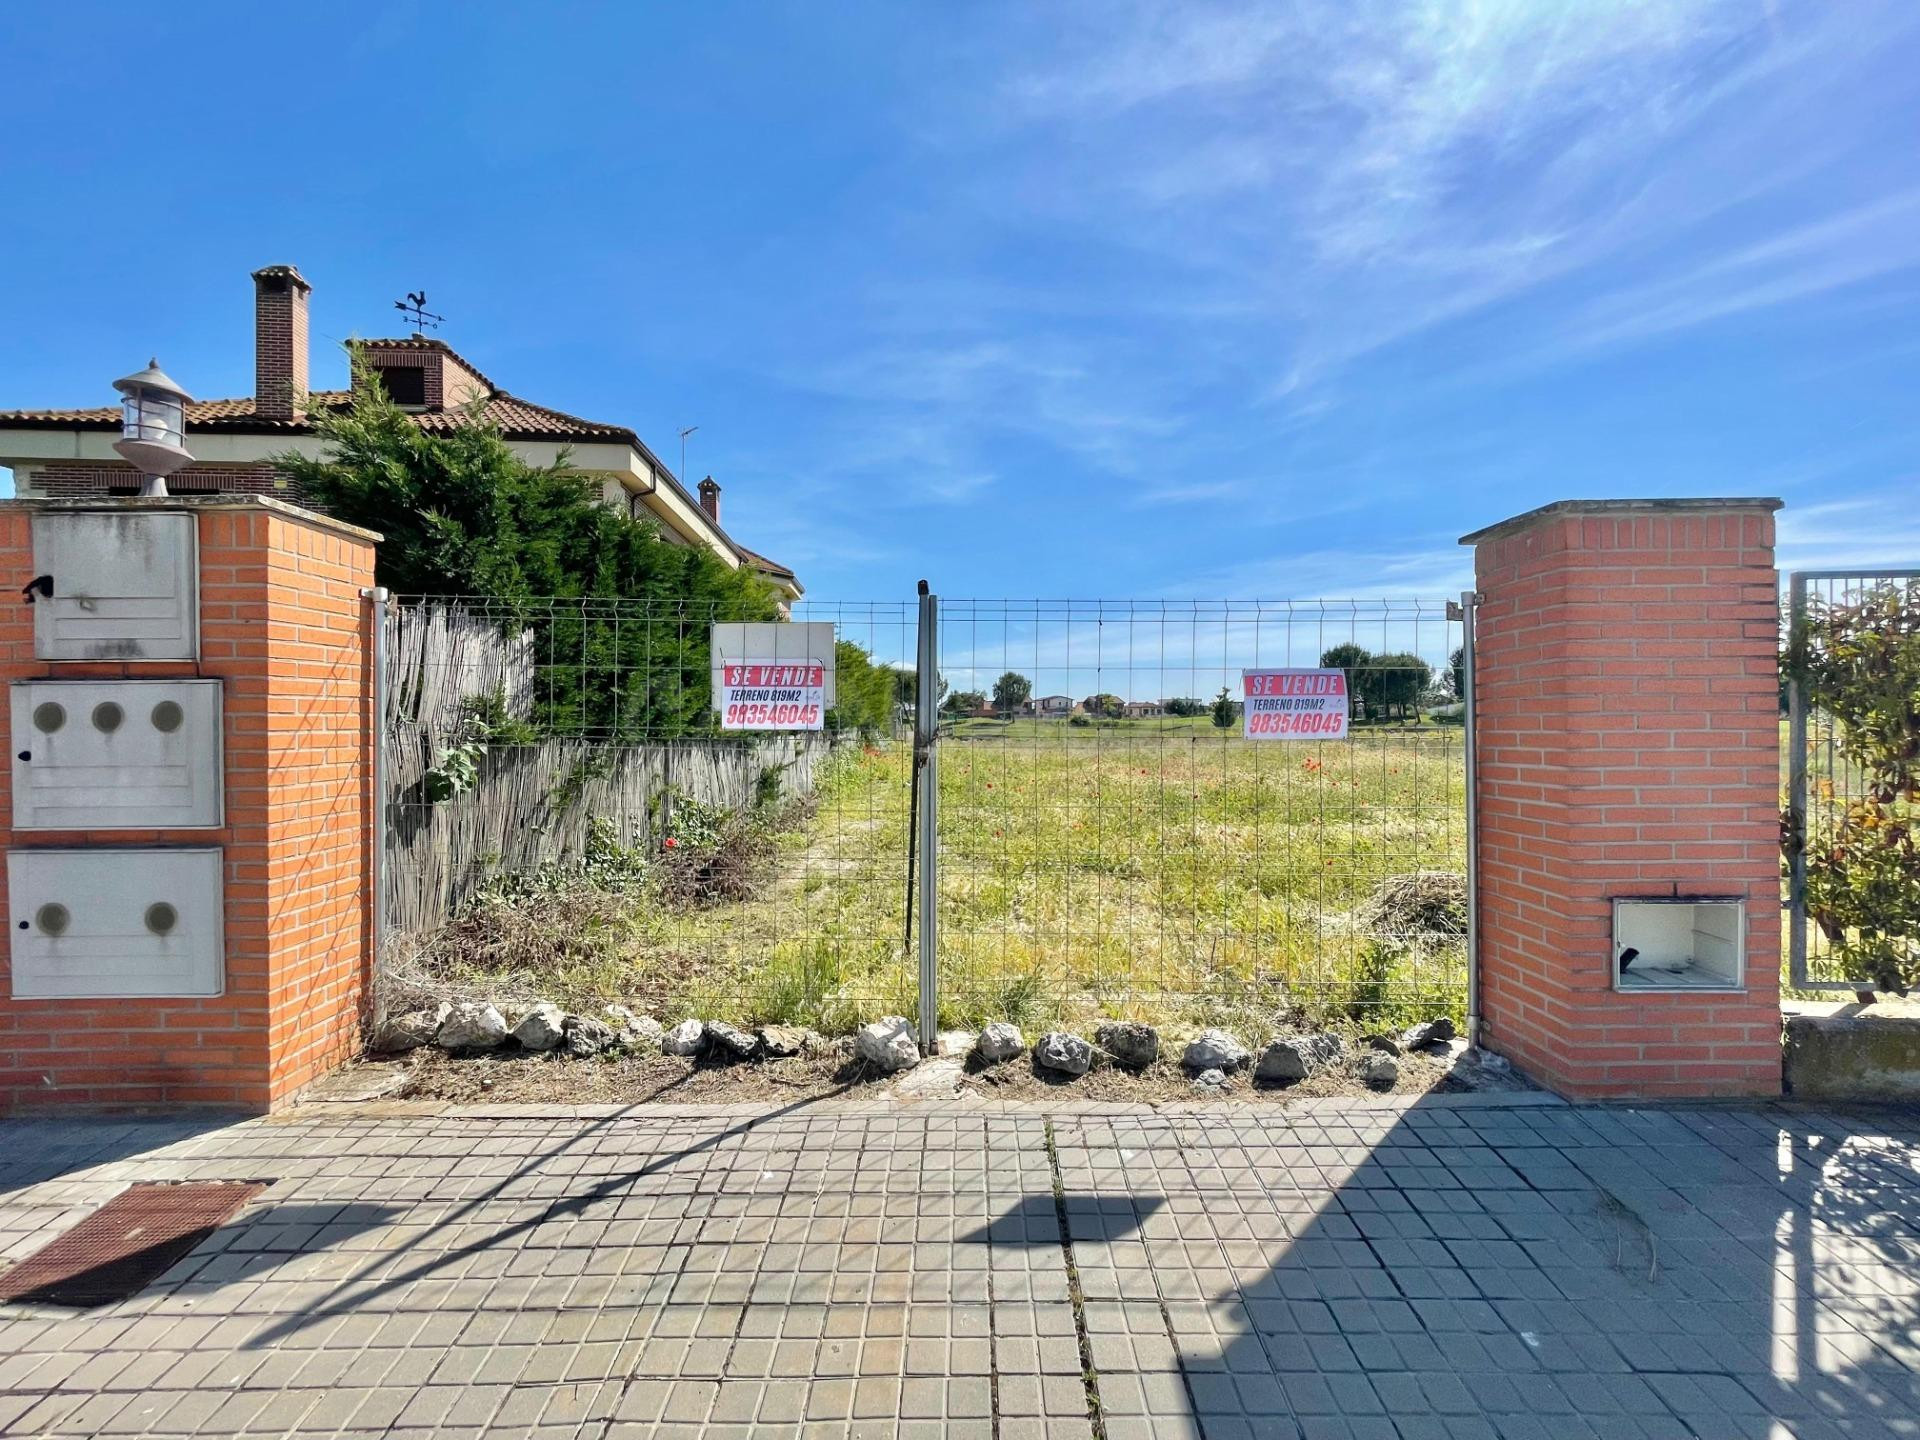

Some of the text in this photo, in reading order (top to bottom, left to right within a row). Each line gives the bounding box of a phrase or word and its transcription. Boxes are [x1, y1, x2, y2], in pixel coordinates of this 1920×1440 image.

[731, 667, 816, 685] SE VENDE
[1253, 676, 1338, 694] SE VENDE
[730, 690, 770, 701] TERRENO
[771, 690, 801, 701] 819M2
[1254, 699, 1292, 710] TERRENO
[1294, 699, 1325, 710] 819M2
[727, 704, 819, 724] 983546045
[1250, 713, 1343, 733] 983546045
